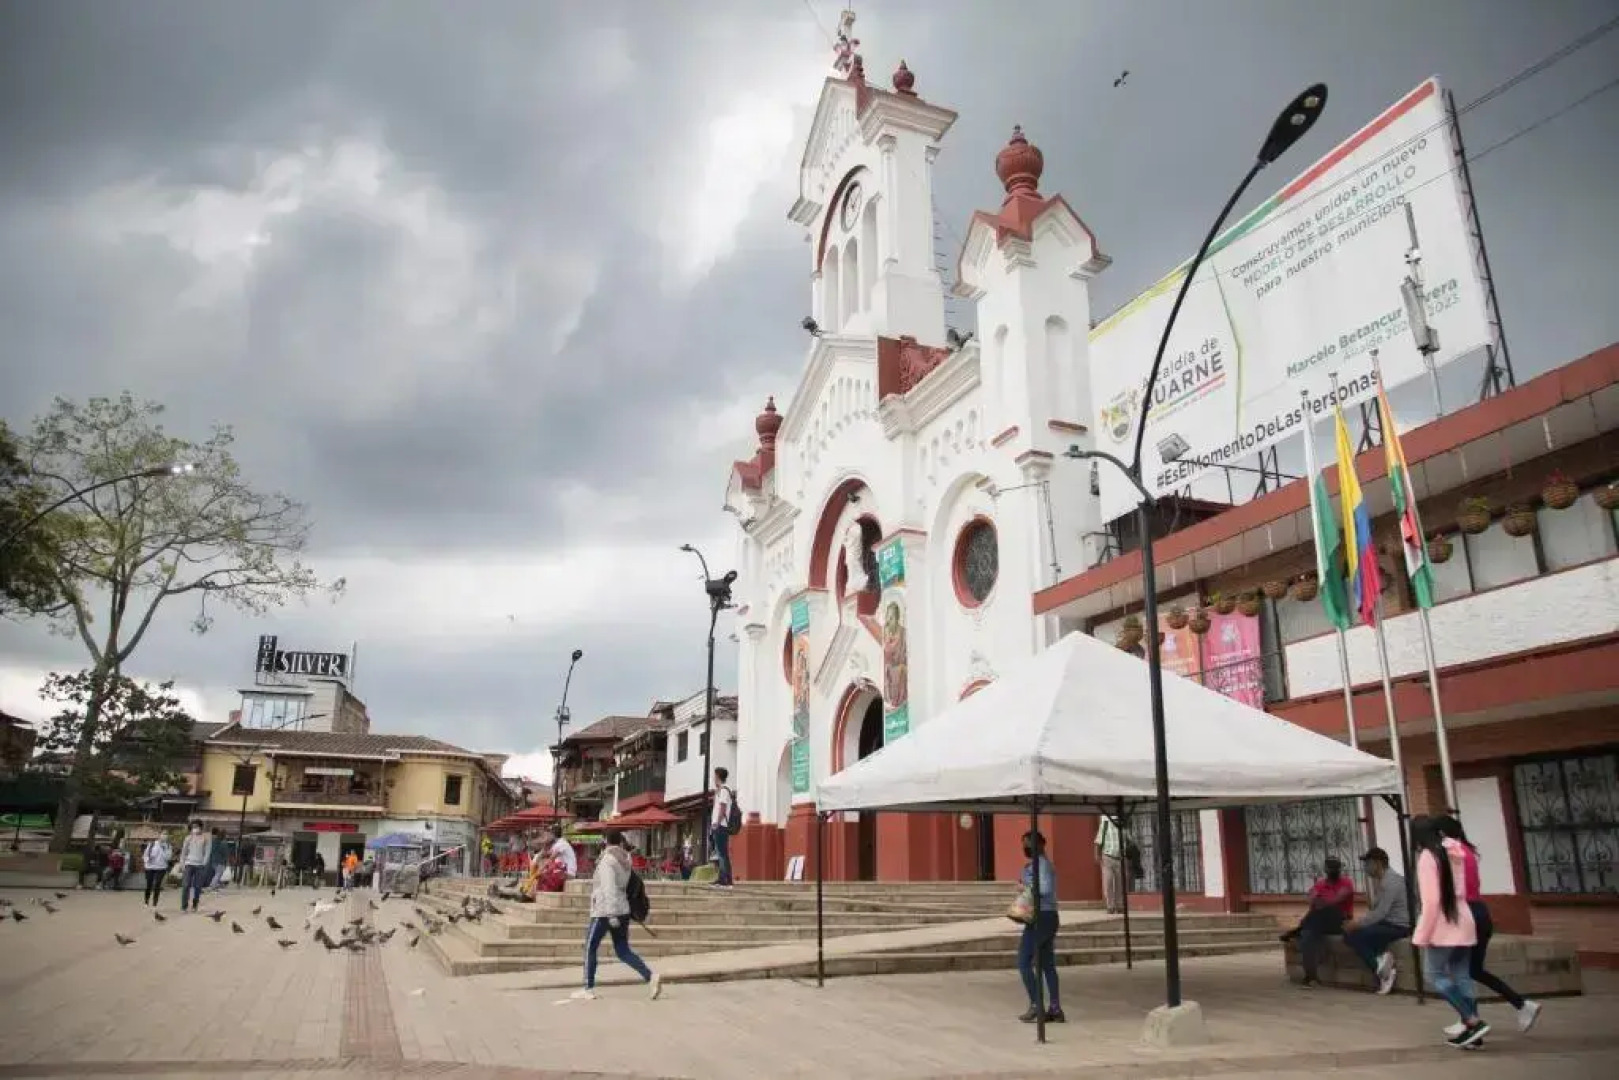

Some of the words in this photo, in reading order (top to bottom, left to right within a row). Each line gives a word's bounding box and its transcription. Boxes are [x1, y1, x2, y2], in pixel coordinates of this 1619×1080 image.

[1231, 219, 1312, 279] Construyamos
[1315, 187, 1358, 222] unidos
[1362, 170, 1378, 189] un
[1382, 138, 1427, 174] nuevo
[1243, 244, 1294, 287] MODELO
[1297, 231, 1314, 251] DE
[1318, 165, 1416, 236] DESARROLLO
[1256, 274, 1282, 300] para
[1286, 241, 1332, 278] nuestro
[1337, 194, 1405, 245] municipio
[1201, 337, 1219, 355] de
[1287, 343, 1336, 378] Marcelo
[1339, 307, 1403, 349] Betancur
[1147, 351, 1223, 411] UARNE
[281, 652, 342, 676] SILVER
